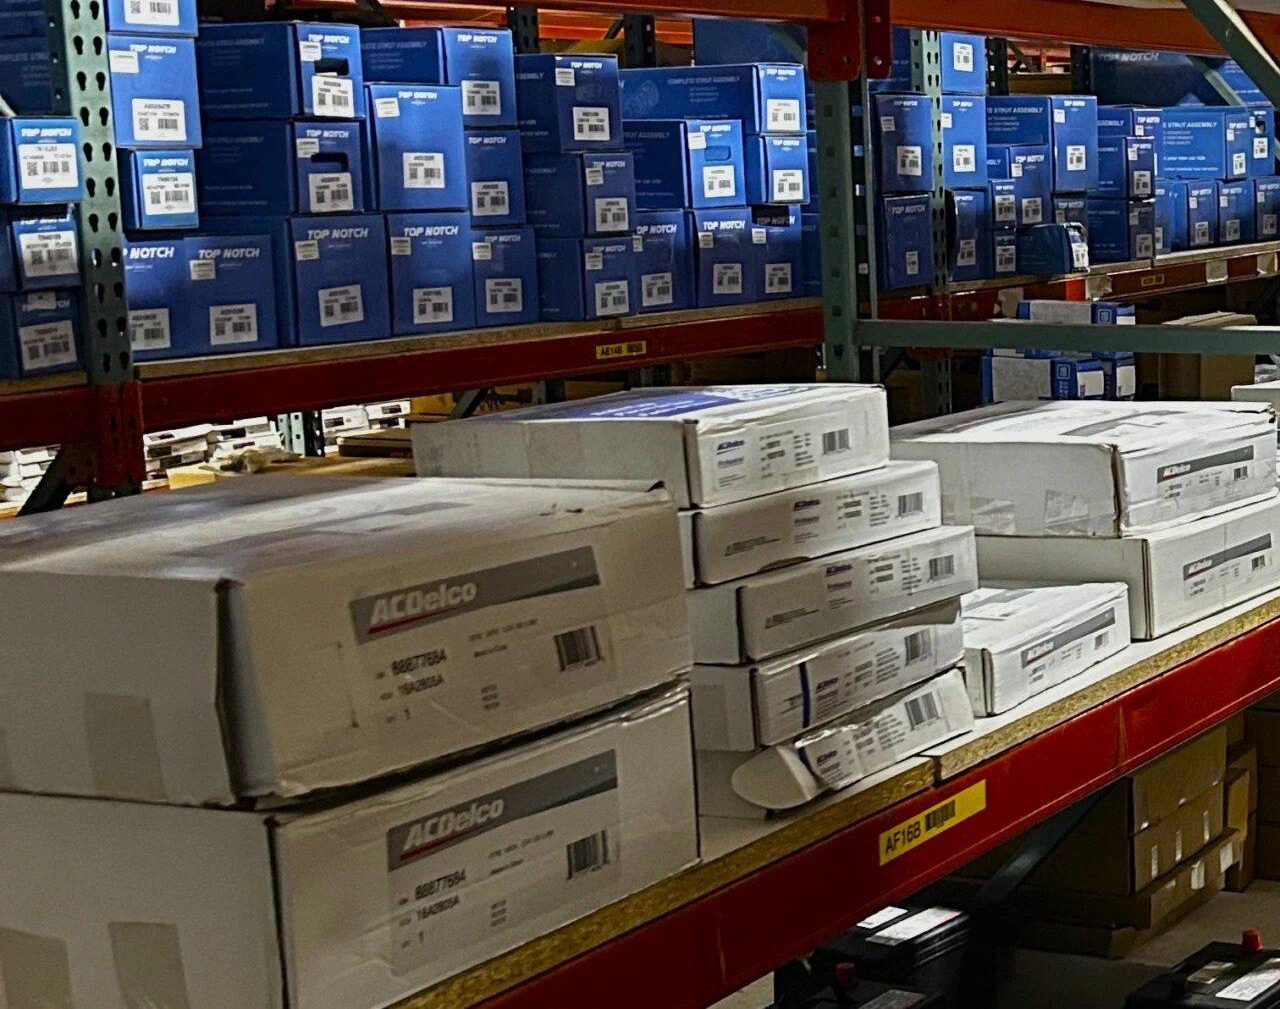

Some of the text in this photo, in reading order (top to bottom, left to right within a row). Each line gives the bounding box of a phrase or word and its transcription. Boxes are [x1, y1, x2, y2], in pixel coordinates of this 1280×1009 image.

[1121, 52, 1159, 61] NOTCH
[21, 128, 72, 137] TOP NOTCH
[306, 130, 349, 138] TOP NOTCH
[161, 158, 189, 166] NOTCH
[636, 226, 649, 234] OP
[703, 220, 746, 230] TOP NOTCH
[308, 228, 368, 240] TOP NOTCH
[403, 226, 458, 237] TOP NOTCH
[129, 246, 174, 259] NOTCH
[198, 248, 260, 259] TOP NOTCH
[1163, 464, 1190, 477] ACDelco
[370, 581, 477, 625] ACDelco
[403, 798, 504, 849] ACDelco
[886, 821, 921, 855] AF16B
